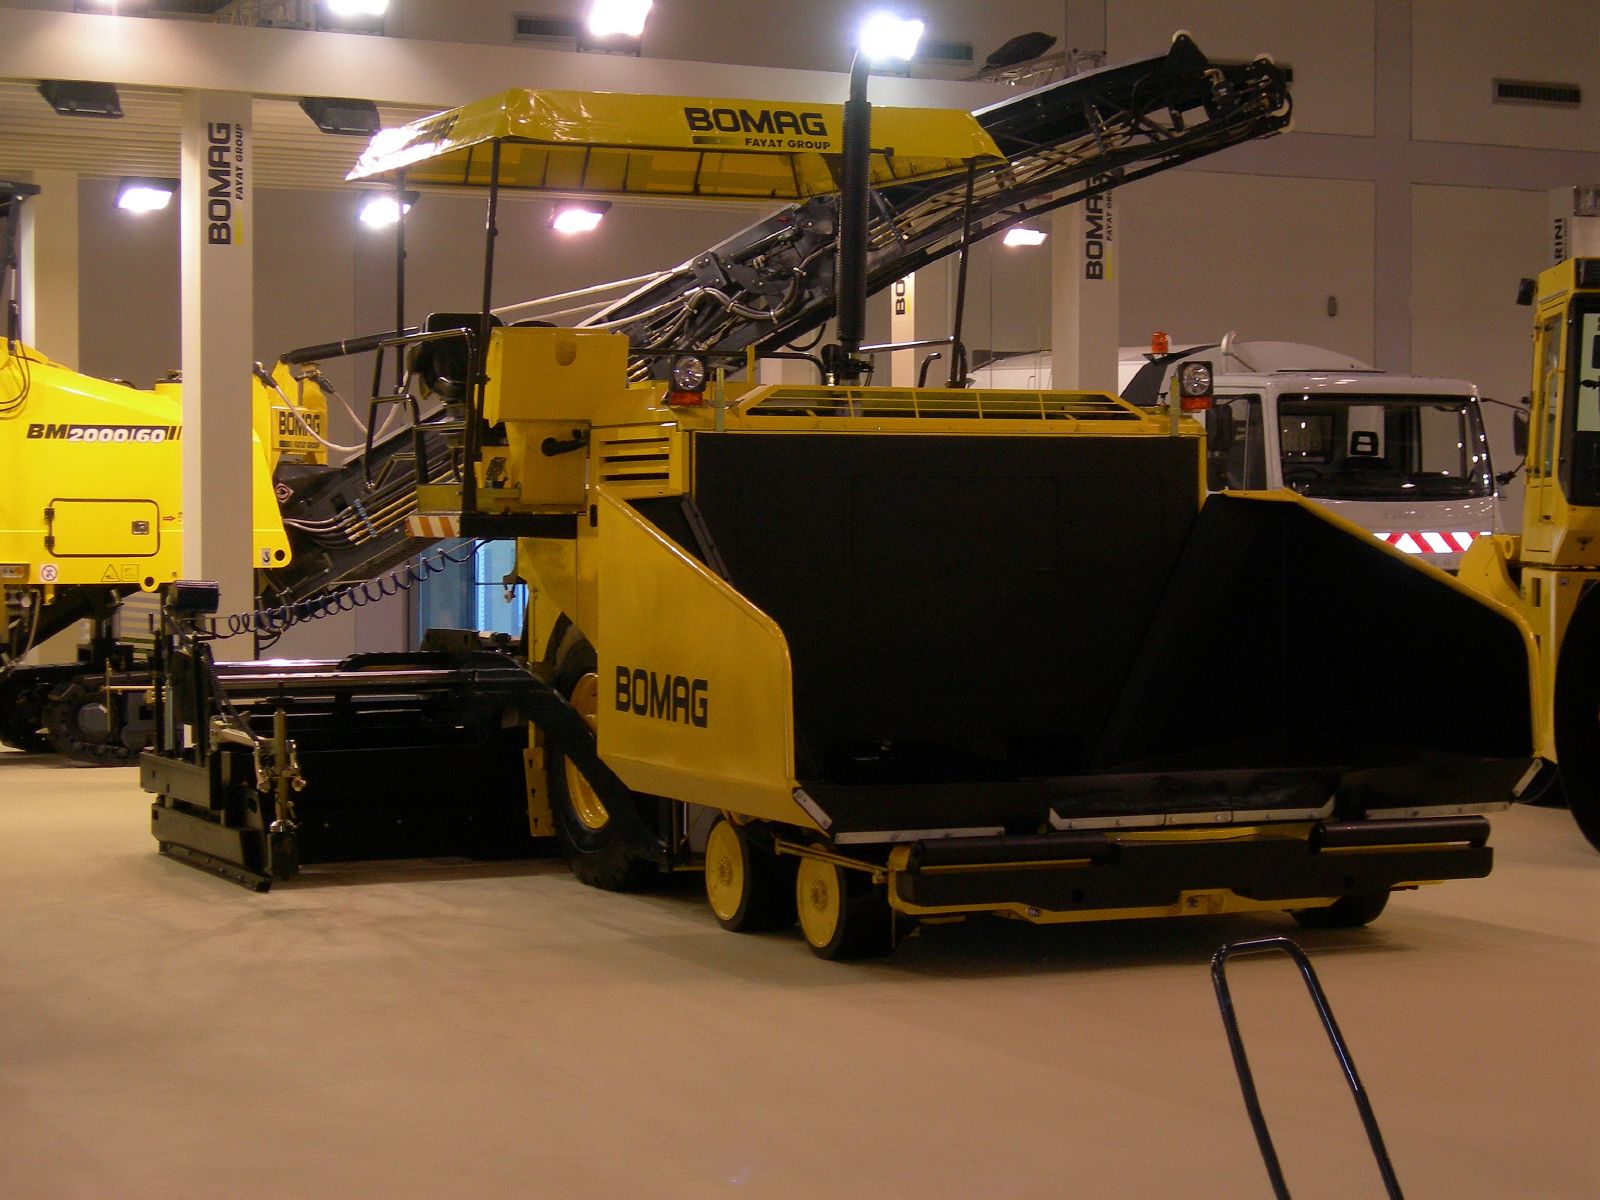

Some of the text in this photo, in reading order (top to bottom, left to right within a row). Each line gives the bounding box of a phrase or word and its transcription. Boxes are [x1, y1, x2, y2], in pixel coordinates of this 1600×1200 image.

[684, 107, 828, 136] BOMAG
[745, 137, 831, 150] FAYAT GROUP
[208, 122, 231, 245] BOMAG
[235, 123, 244, 200] FAYAT GROUP
[615, 665, 708, 729] BOMAG
